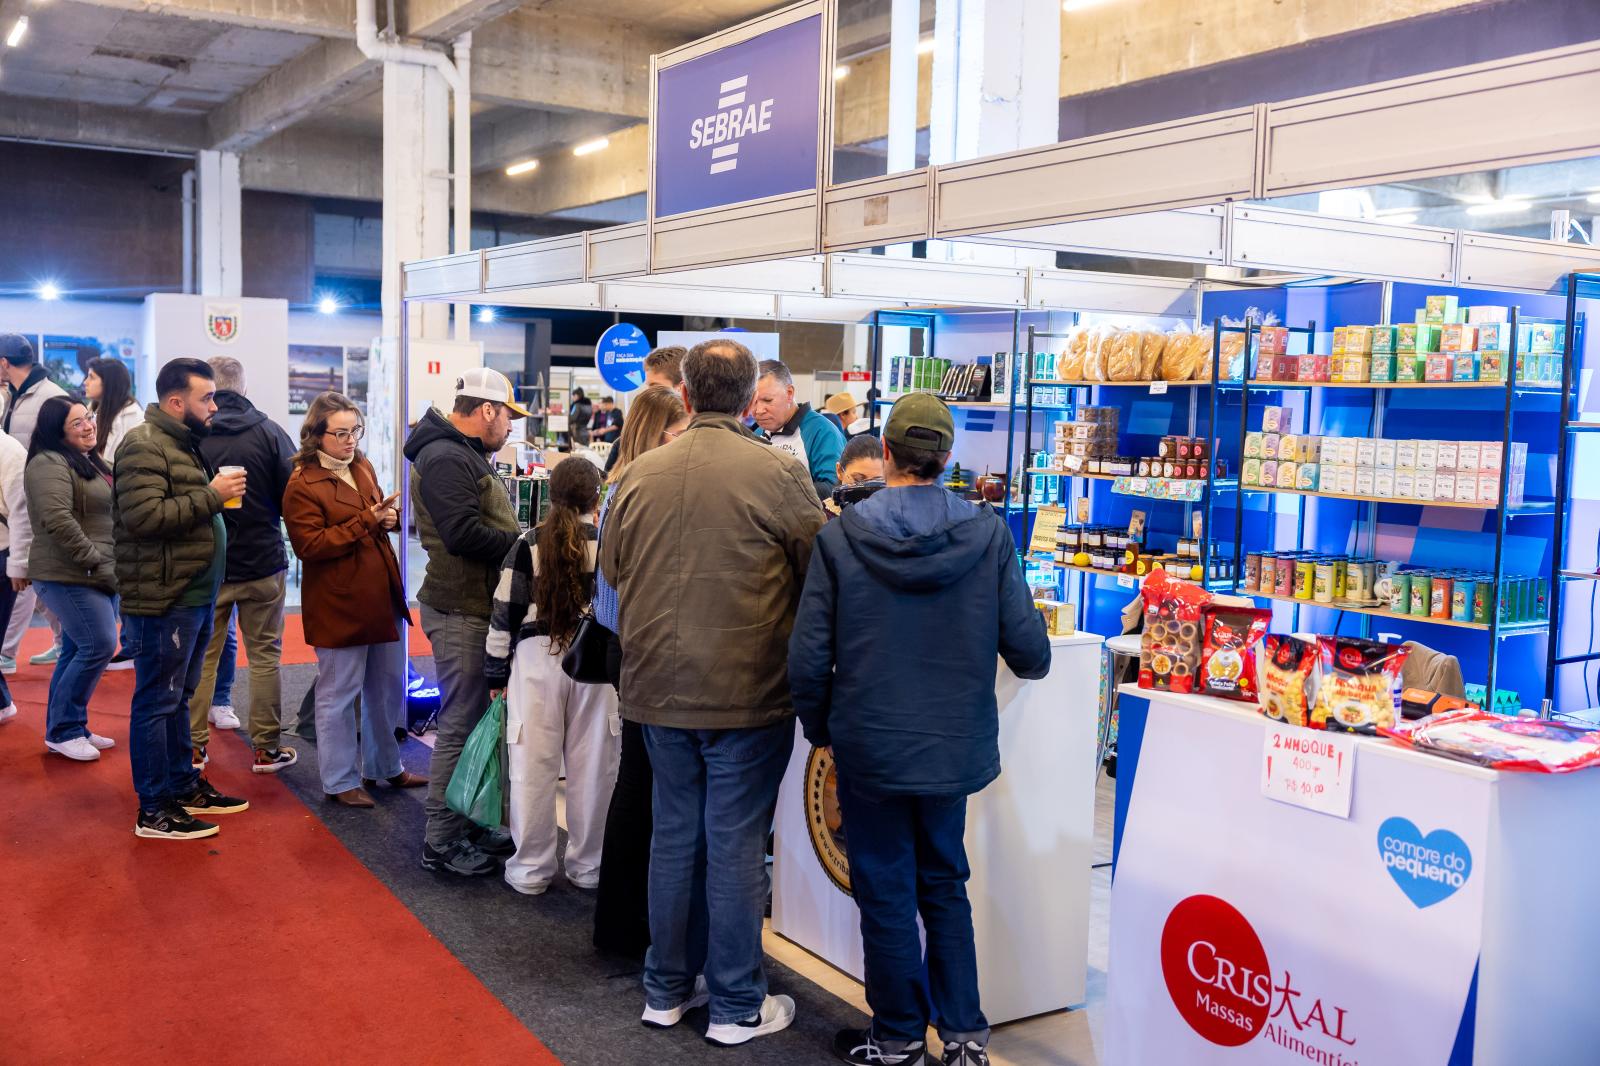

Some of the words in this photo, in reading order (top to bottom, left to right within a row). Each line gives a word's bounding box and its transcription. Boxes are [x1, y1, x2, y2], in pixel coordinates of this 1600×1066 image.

[689, 98, 774, 150] SEBRAE
[1273, 733, 1281, 749] 2
[1383, 836, 1441, 862] compre
[1443, 851, 1466, 872] do
[1383, 850, 1465, 888] pequeno
[1196, 989, 1255, 1032] Massas
